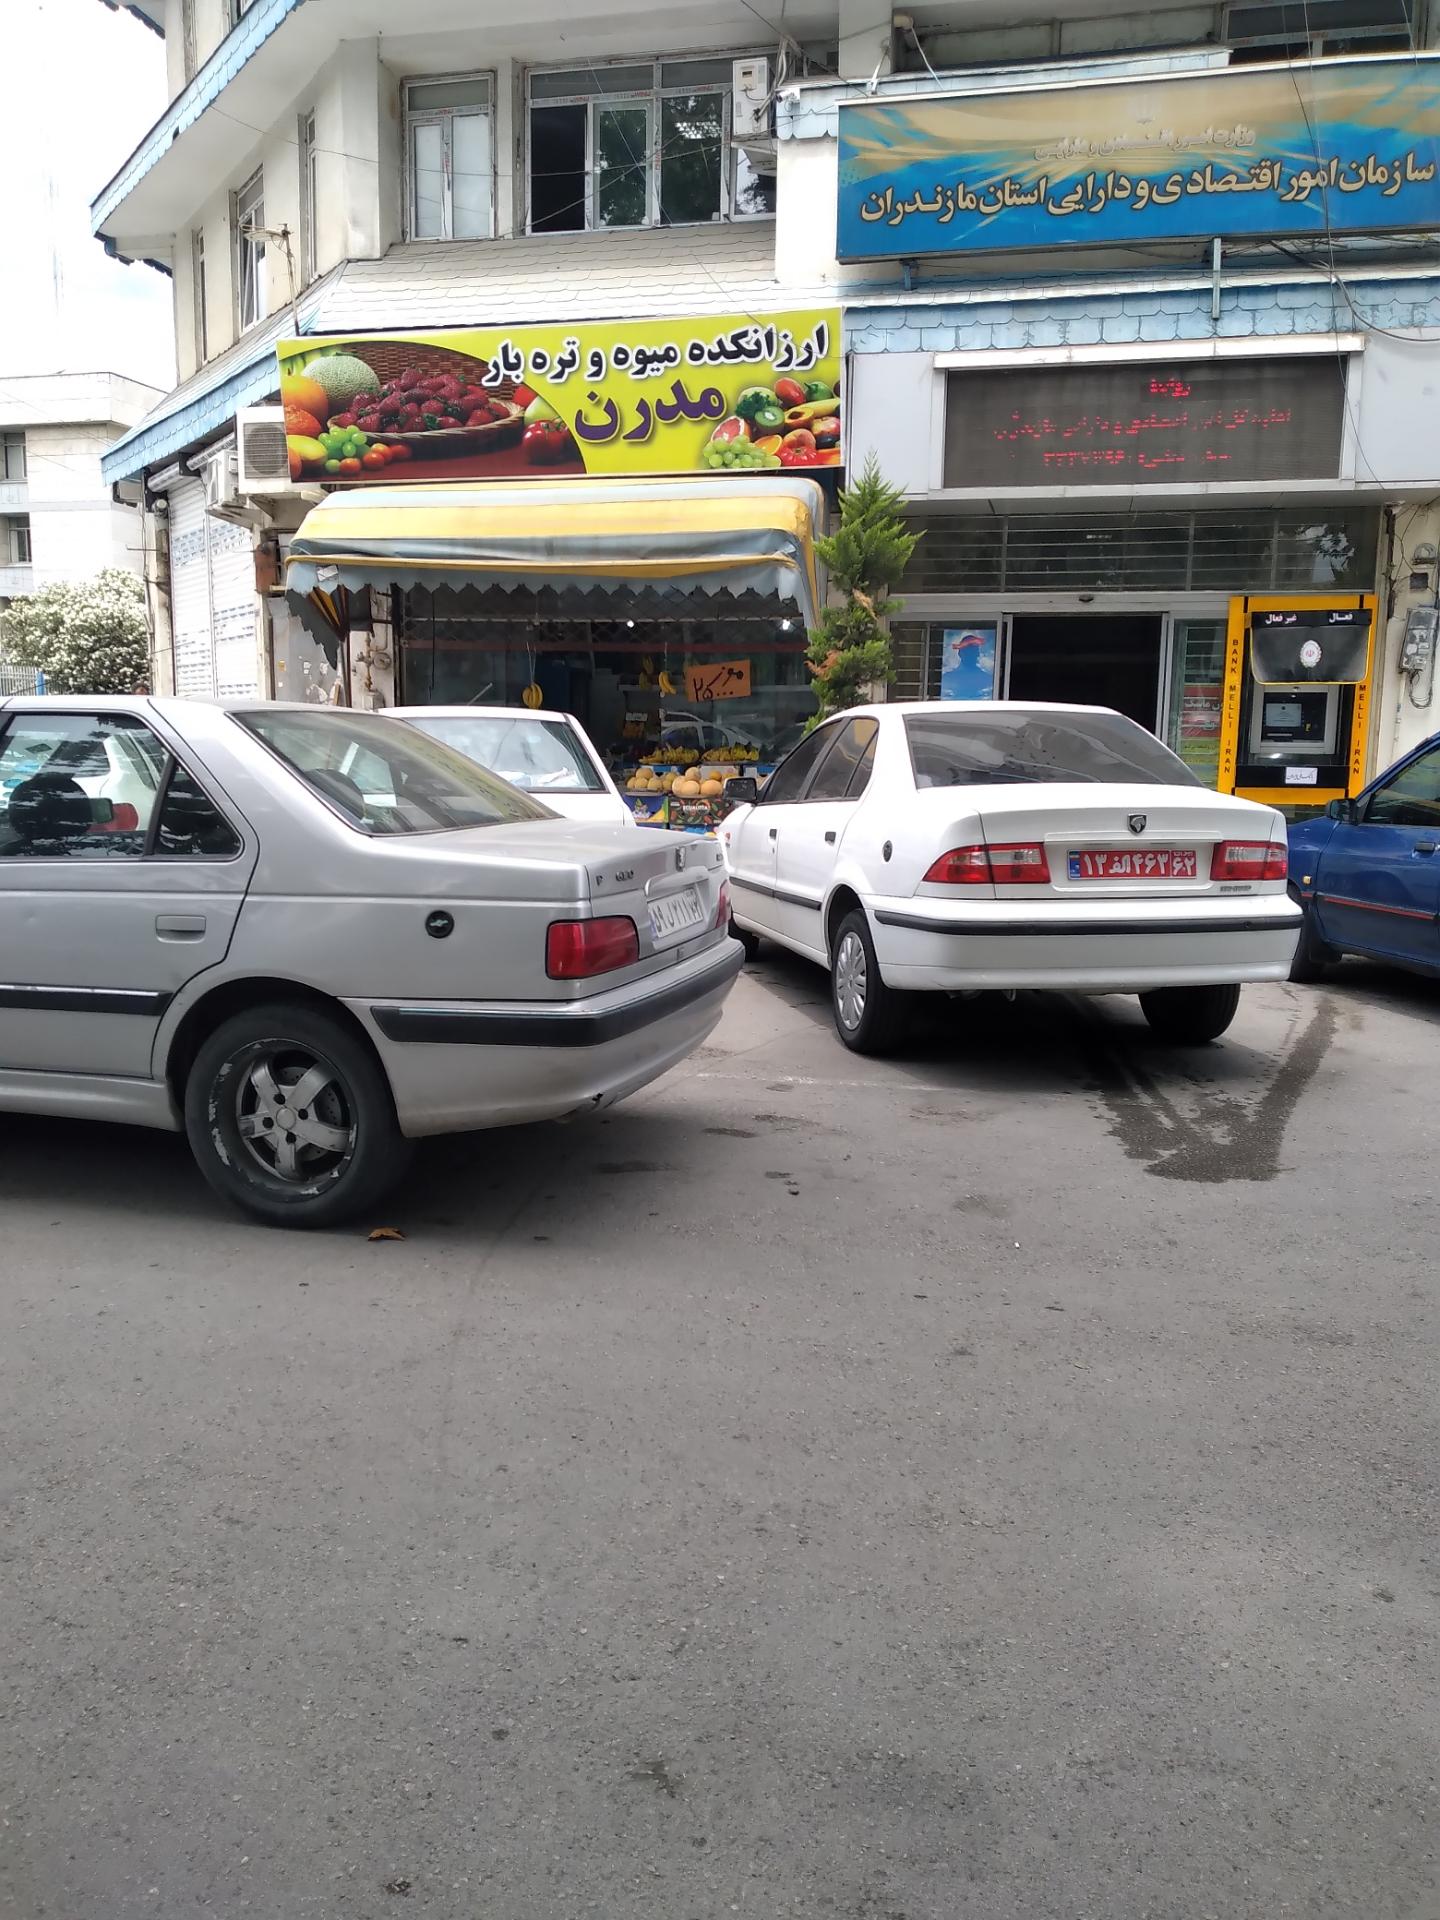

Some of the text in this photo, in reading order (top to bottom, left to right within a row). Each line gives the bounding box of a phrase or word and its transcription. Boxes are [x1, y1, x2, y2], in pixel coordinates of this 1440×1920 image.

[861, 152, 1436, 225] سازمان امور اقتصادی و دارایی استان مازندران
[482, 321, 829, 386] ارزانکده میوه و تره بار
[573, 378, 728, 441] مدرن
[1265, 614, 1283, 625] فعال
[1328, 612, 1353, 623] فعال
[1224, 639, 1239, 774] BANK MELLI IRAN
[1353, 685, 1367, 774] MELLI IRAN
[1084, 853, 1169, 875] ۱۳ الف ۴۶۳
[1173, 856, 1195, 876] ۶۲
